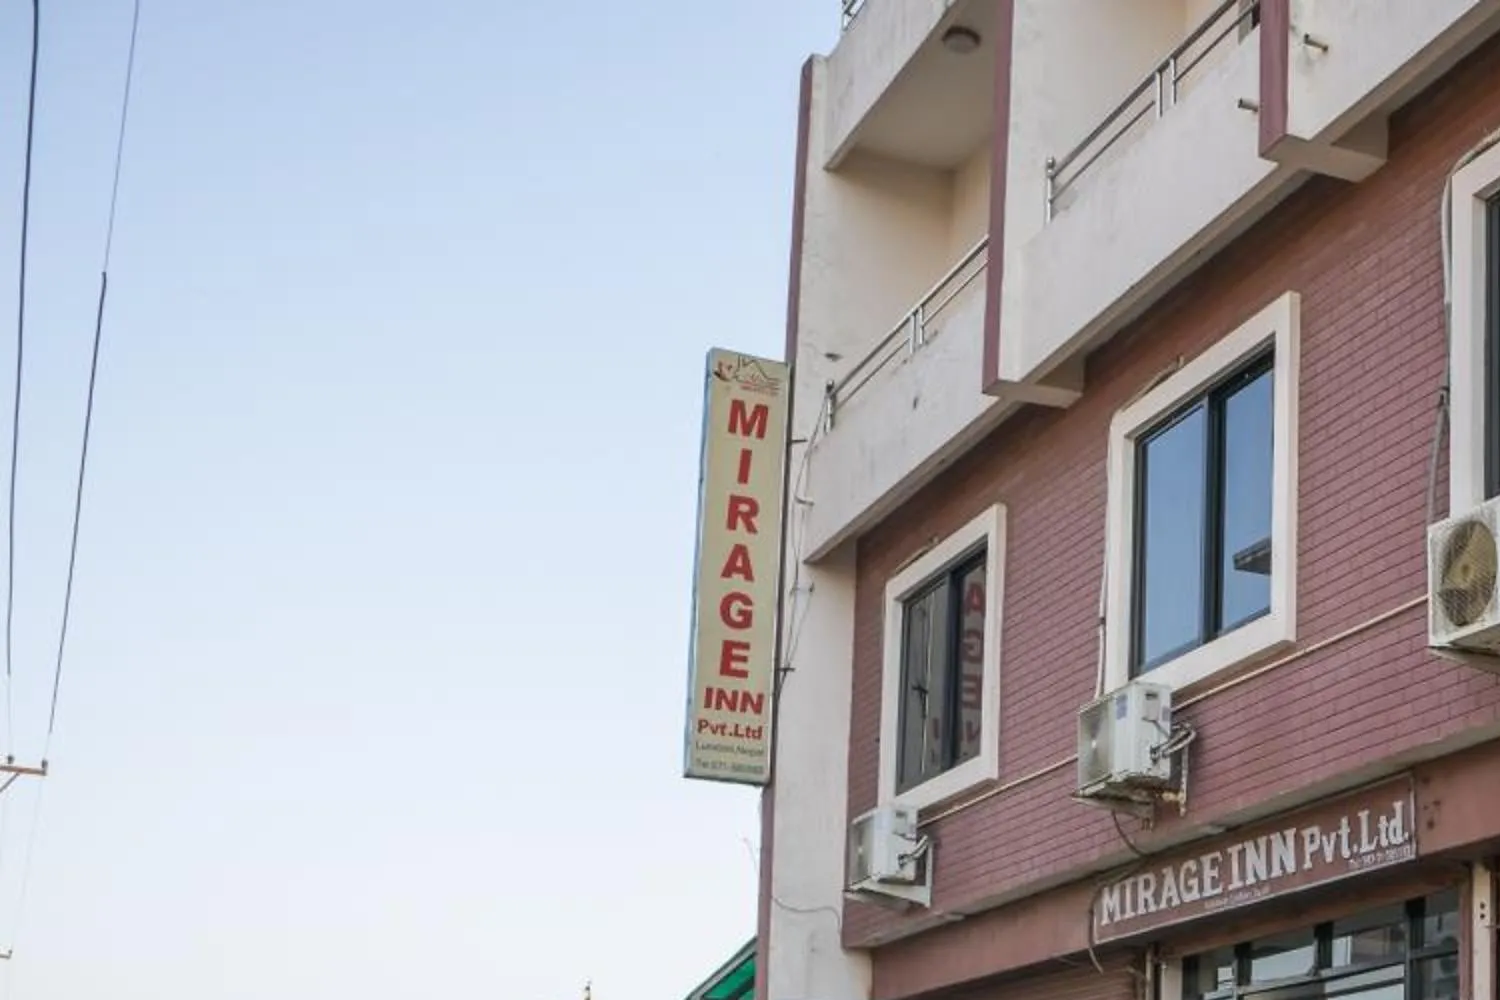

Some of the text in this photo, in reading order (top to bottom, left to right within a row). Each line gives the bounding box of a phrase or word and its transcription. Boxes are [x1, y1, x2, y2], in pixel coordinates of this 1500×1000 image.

[719, 399, 769, 679] MIRAGE
[704, 687, 765, 715] INN
[1101, 851, 1224, 926] MIRAGE
[1228, 827, 1297, 891] INN
